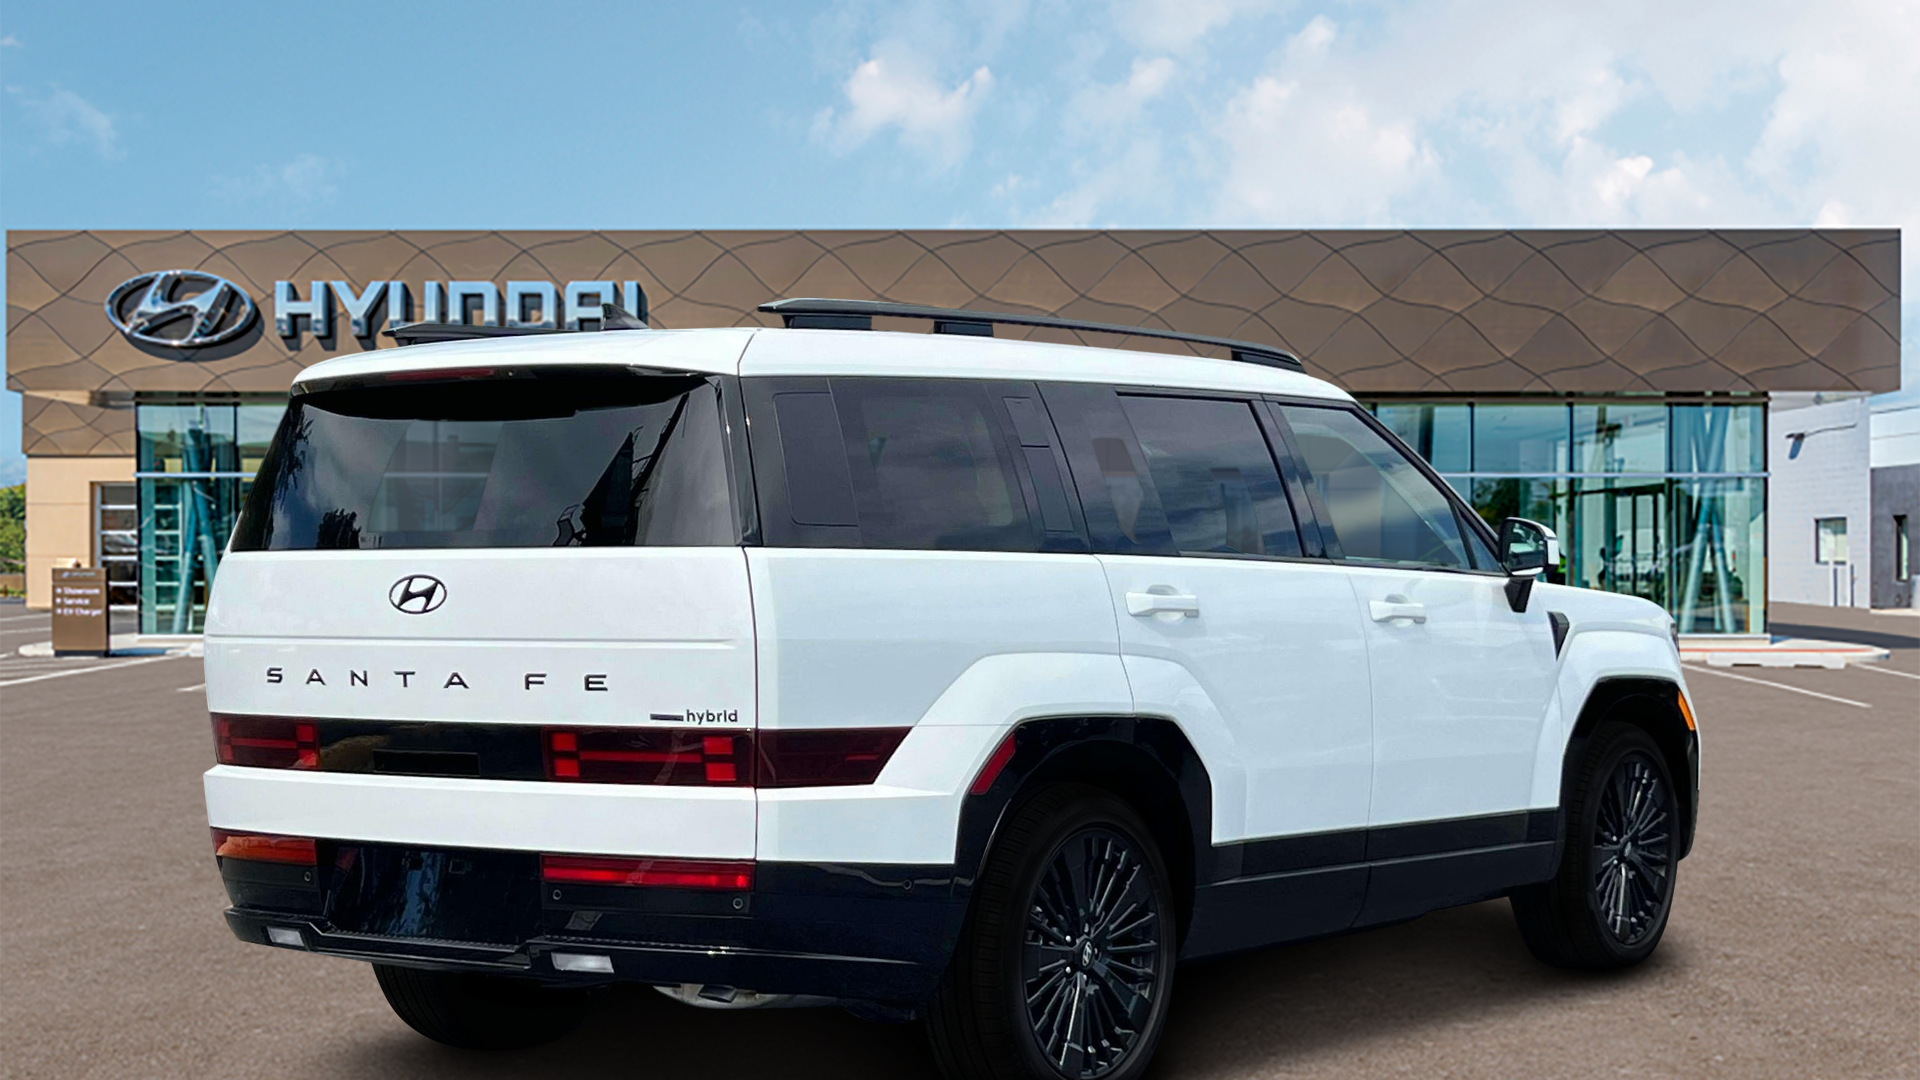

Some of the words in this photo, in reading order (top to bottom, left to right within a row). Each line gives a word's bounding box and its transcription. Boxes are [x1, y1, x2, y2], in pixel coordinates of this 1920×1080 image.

[275, 281, 640, 336] HYUNDAI
[266, 667, 469, 689] SANTA
[524, 673, 608, 691] FE
[686, 709, 738, 725] hybrid
